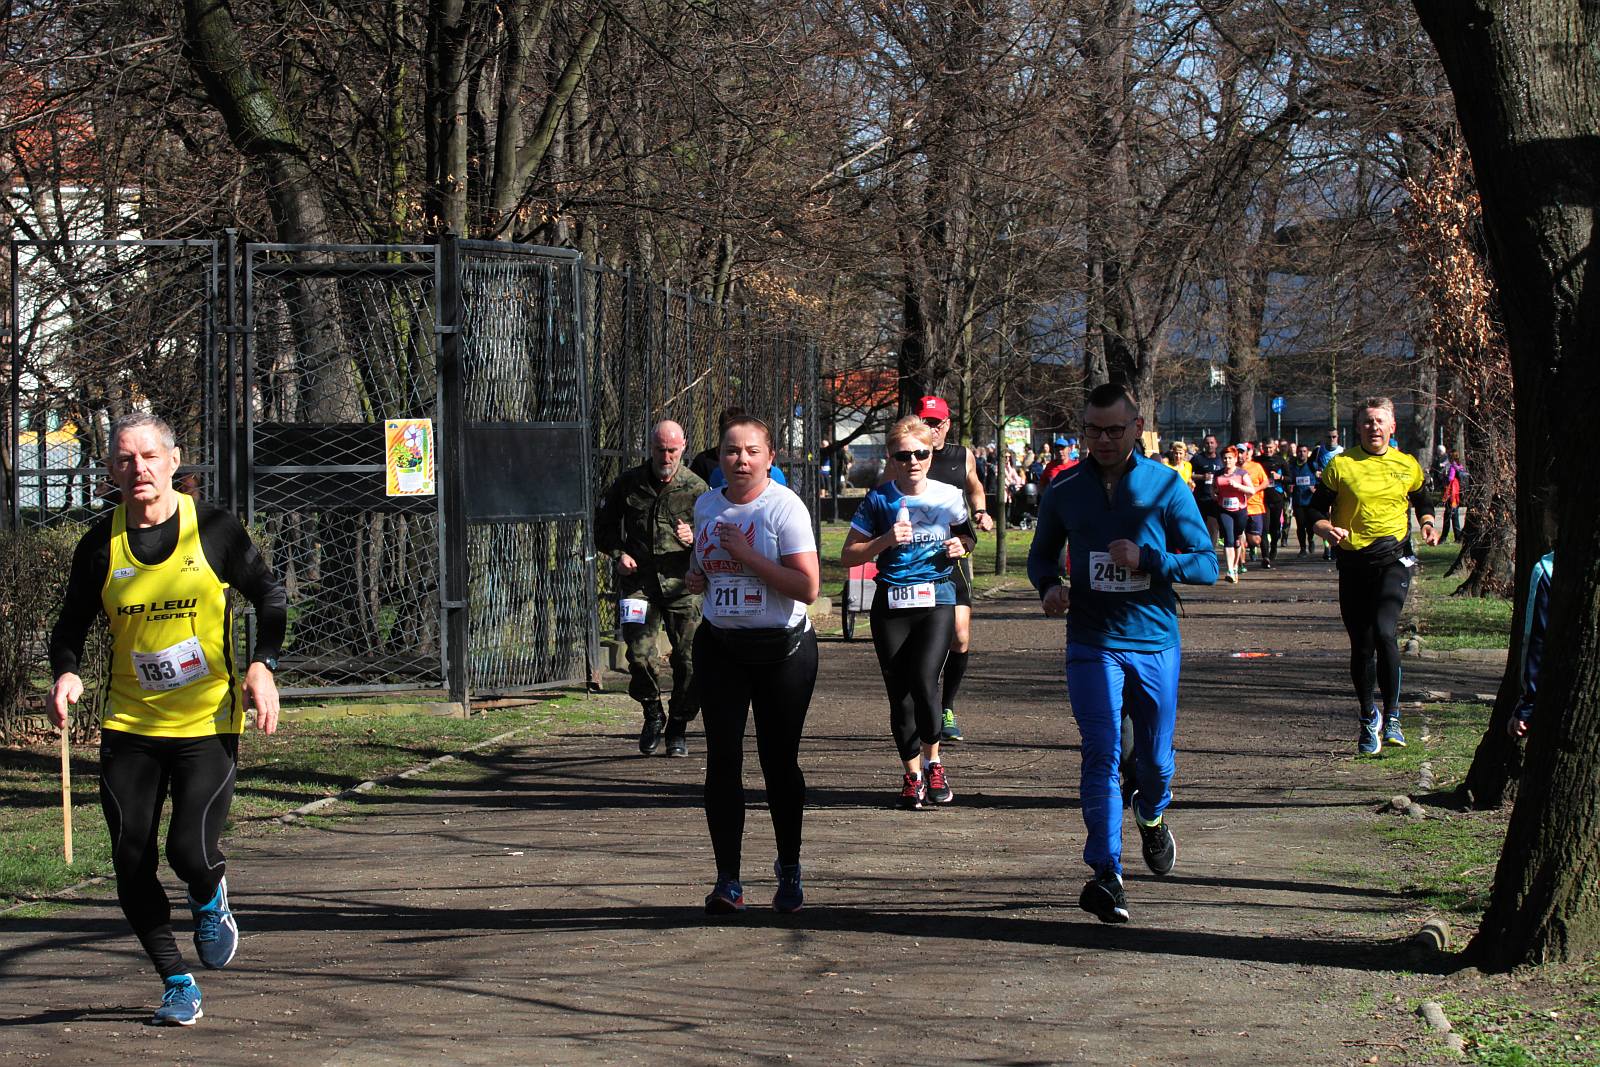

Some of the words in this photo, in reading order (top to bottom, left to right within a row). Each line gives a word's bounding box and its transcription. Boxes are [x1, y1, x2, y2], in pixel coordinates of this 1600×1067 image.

[704, 560, 744, 571] TEAM
[1094, 562, 1126, 582] 245
[715, 587, 738, 606] 211
[892, 586, 915, 601] 081
[117, 603, 146, 616] KB
[150, 599, 198, 611] LEW
[147, 612, 198, 621] LEGNICA
[139, 660, 177, 681] 133
